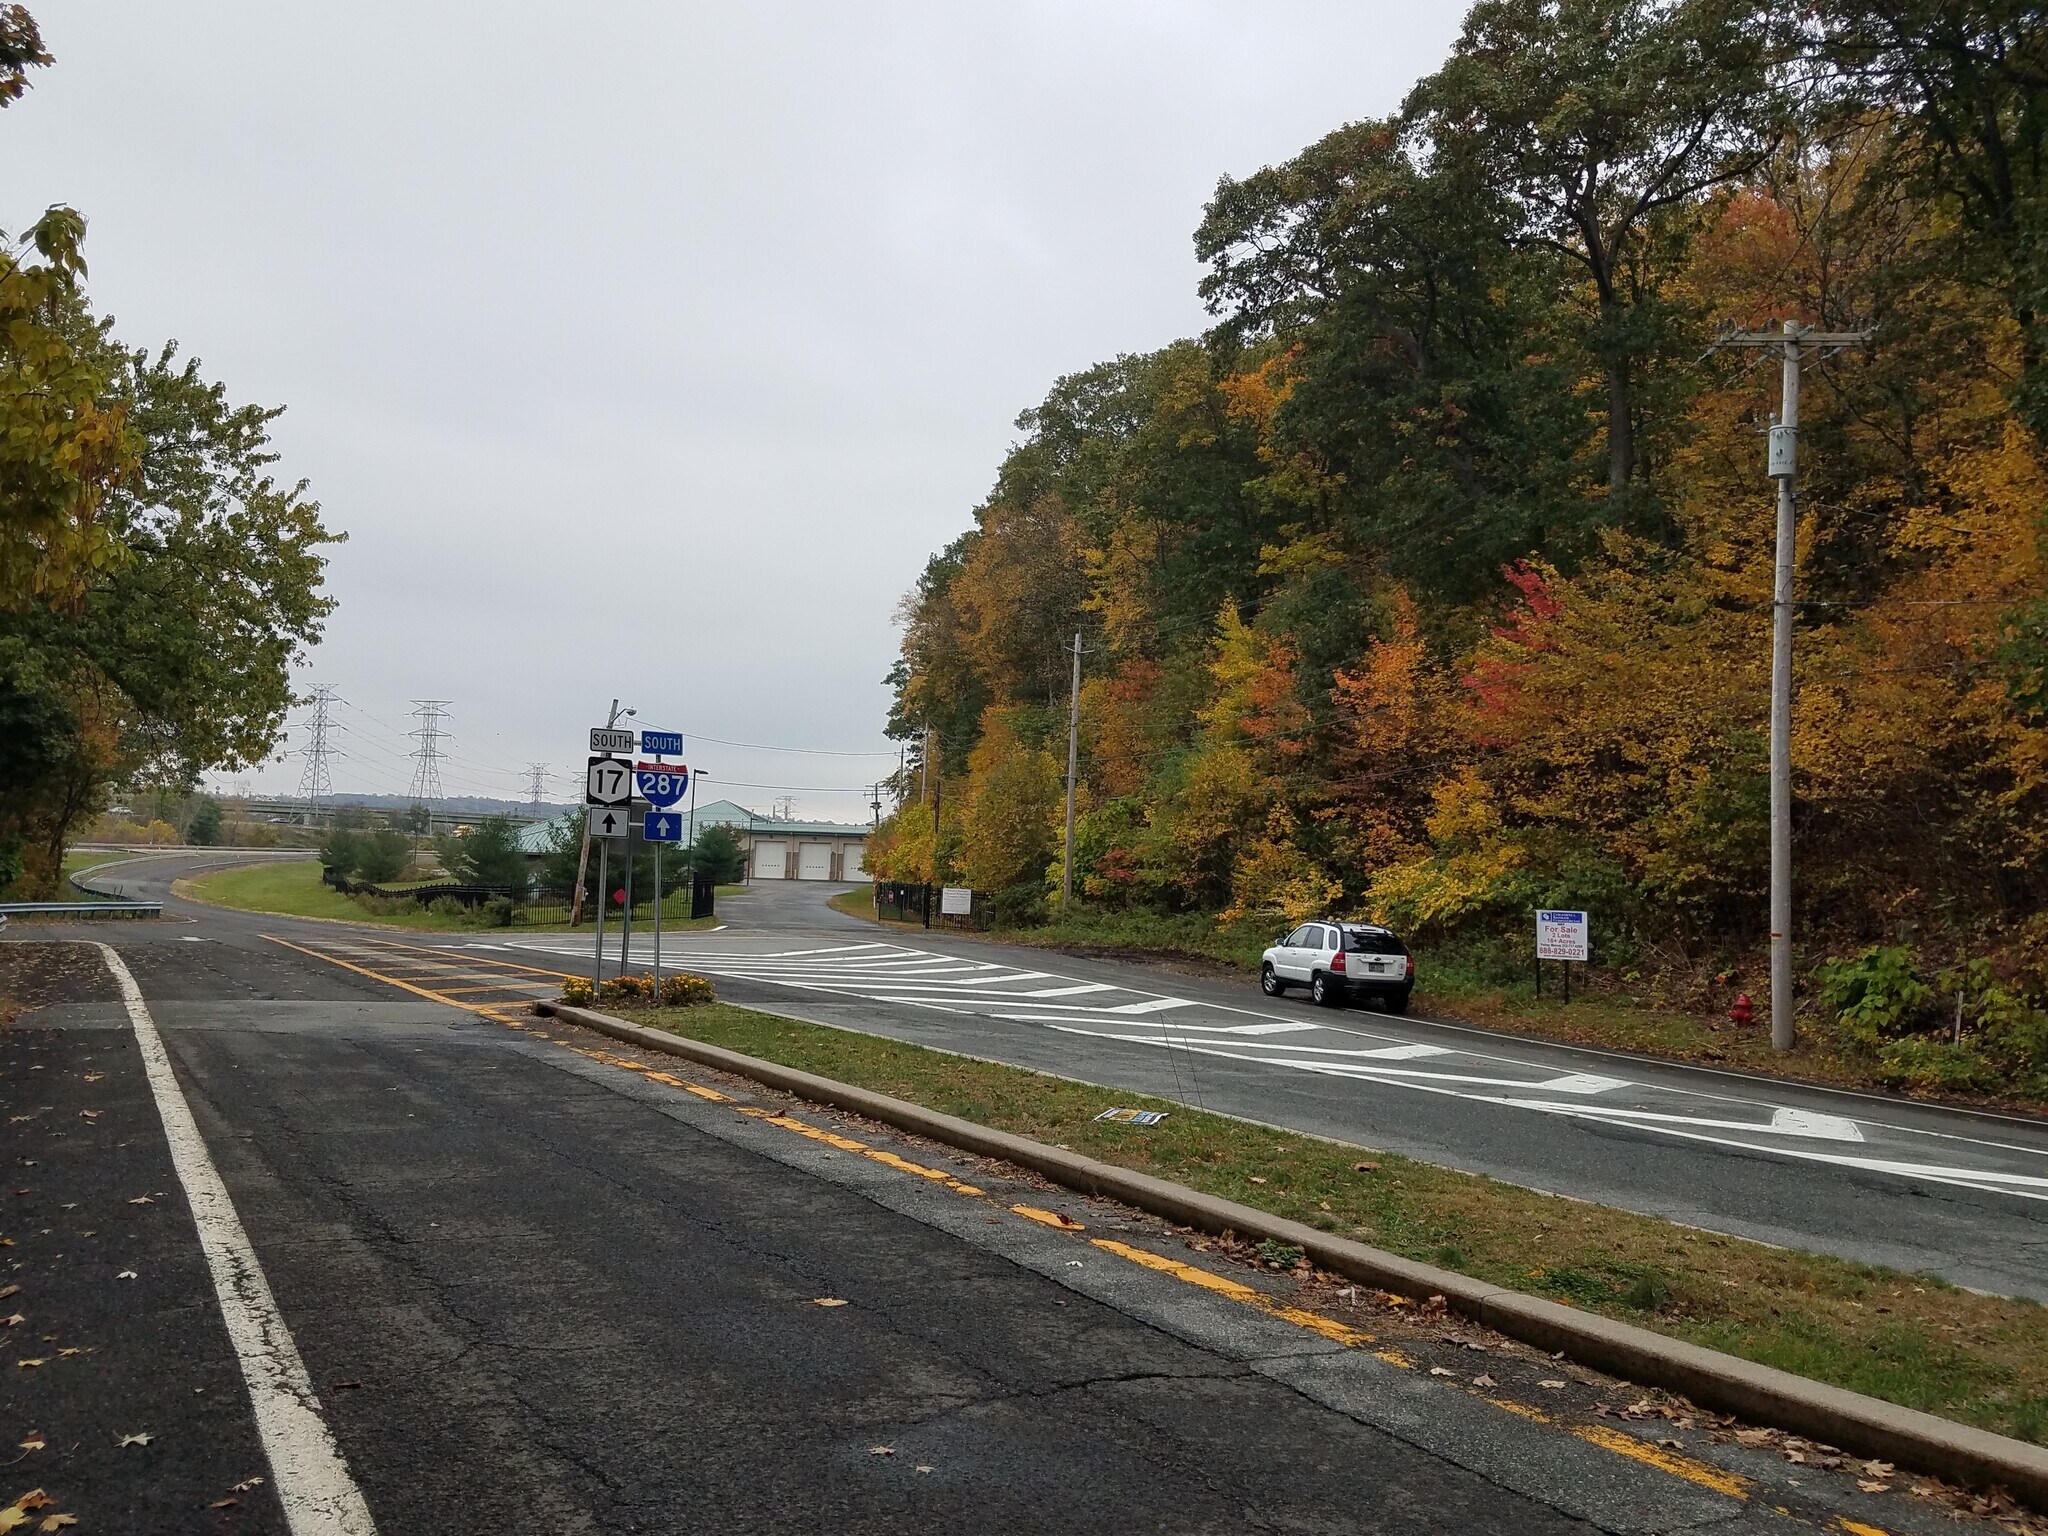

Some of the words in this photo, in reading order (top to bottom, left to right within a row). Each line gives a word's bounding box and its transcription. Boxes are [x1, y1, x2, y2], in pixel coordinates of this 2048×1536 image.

[592, 733, 631, 749] SOUTH
[644, 736, 681, 751] SOUTH
[596, 769, 624, 795] 17
[642, 773, 685, 796] 287
